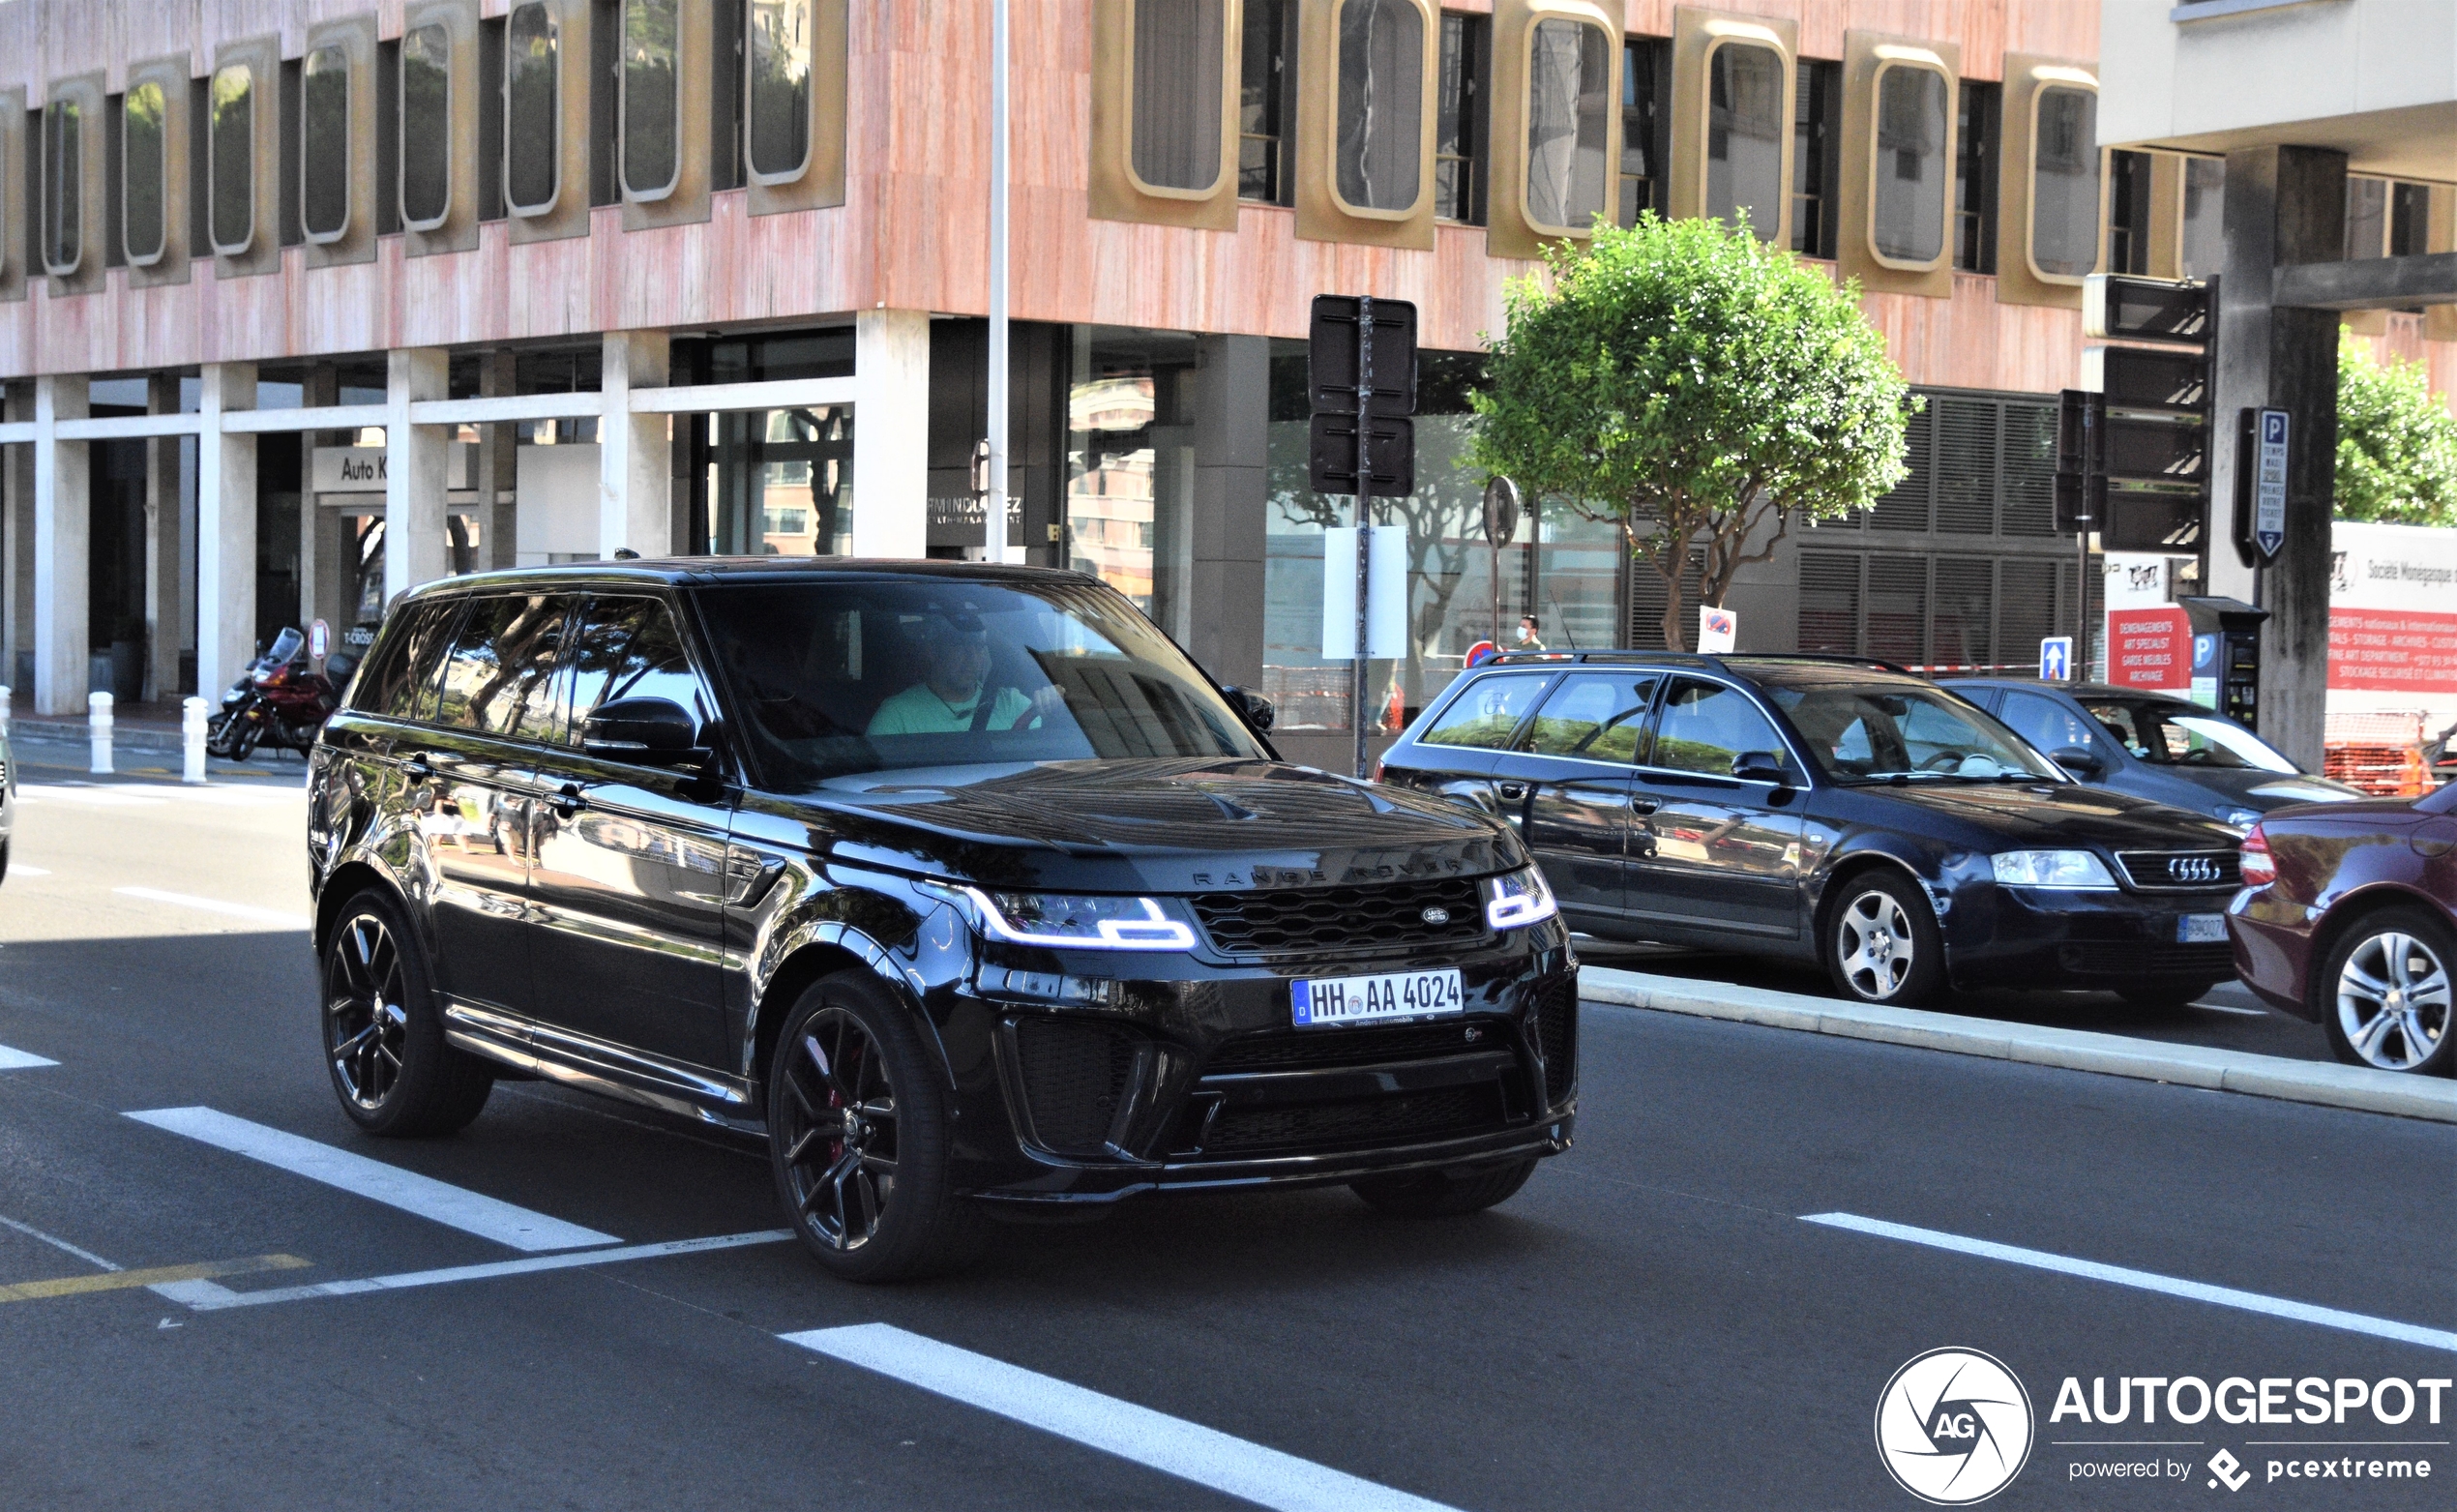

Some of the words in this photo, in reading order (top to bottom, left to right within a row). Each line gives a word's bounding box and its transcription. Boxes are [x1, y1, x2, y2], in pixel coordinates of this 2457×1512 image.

[341, 455, 373, 481] Auto
[378, 456, 387, 480] K
[2400, 561, 2452, 587] Monégasque
[2197, 637, 2209, 662] P
[1193, 870, 1327, 886] RANGE
[1351, 860, 1464, 879] ROVER
[1312, 982, 1346, 1017] HH
[1367, 979, 1397, 1013] AA
[1403, 973, 1460, 1009] 4024
[1299, 1006, 1306, 1016] D
